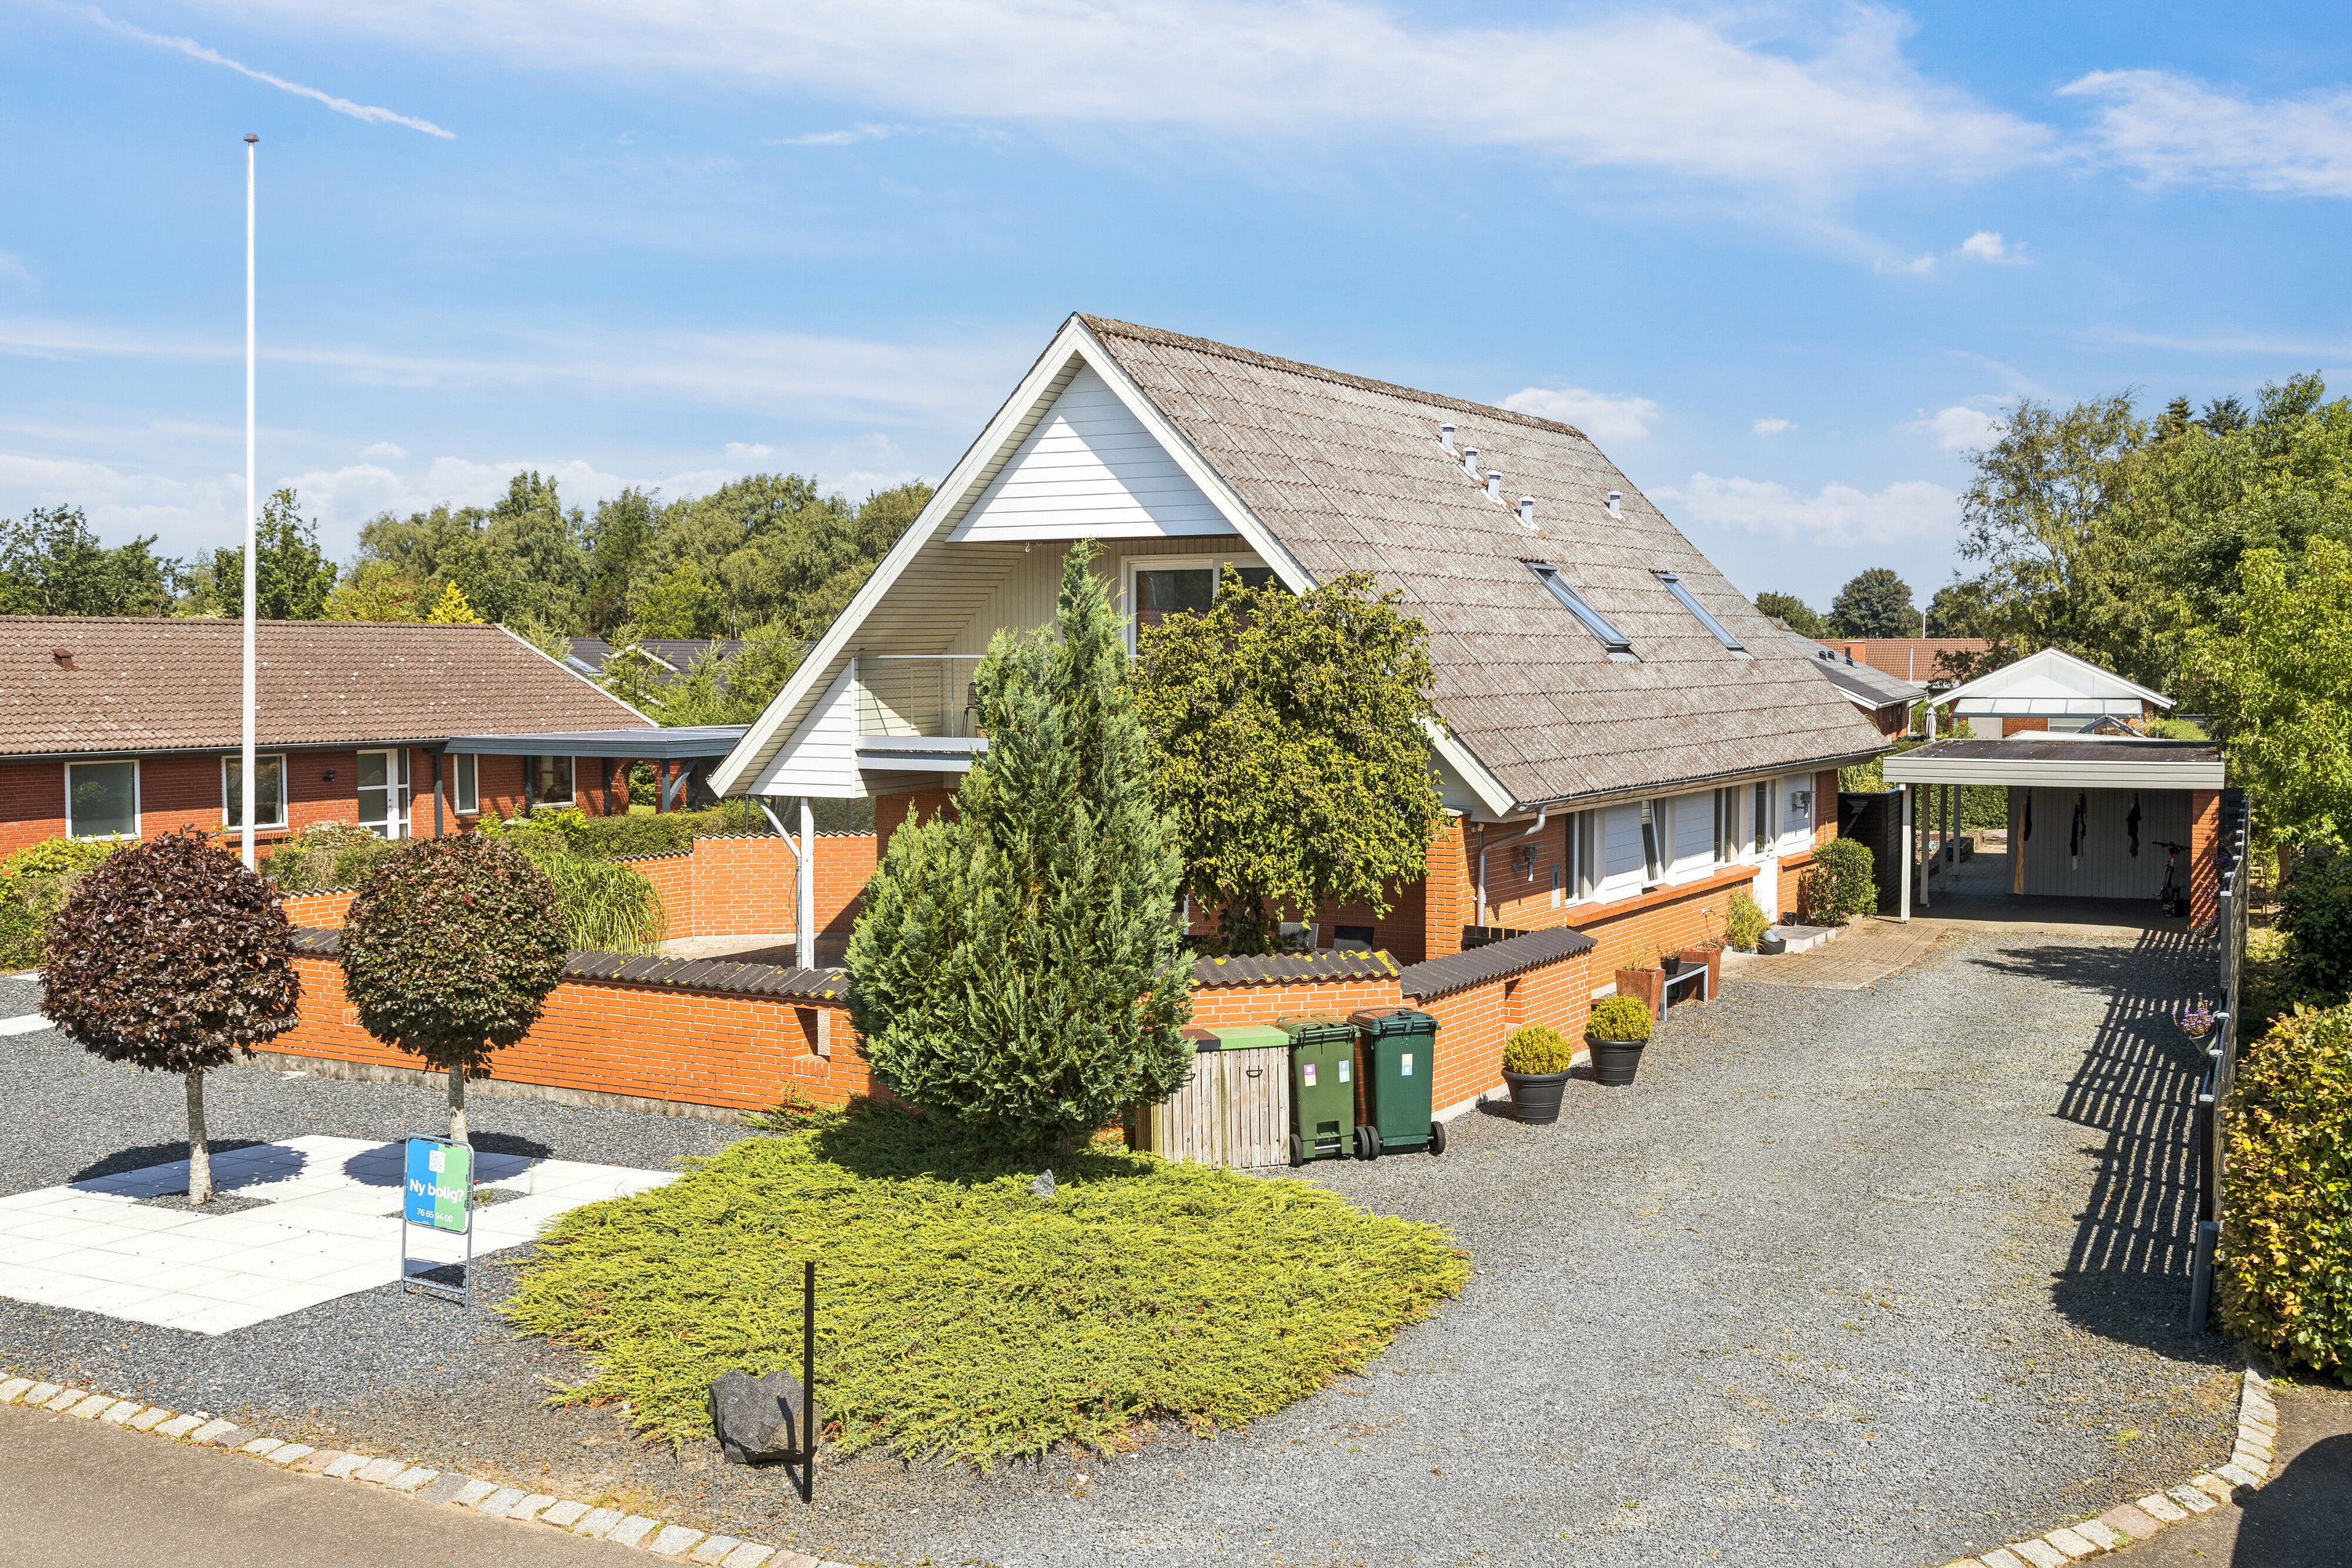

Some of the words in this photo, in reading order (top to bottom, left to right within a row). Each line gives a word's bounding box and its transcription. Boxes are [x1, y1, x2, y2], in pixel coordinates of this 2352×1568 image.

[409, 1178, 426, 1196] Ny
[427, 1182, 464, 1203] bolig?
[426, 1210, 434, 1218] 65
